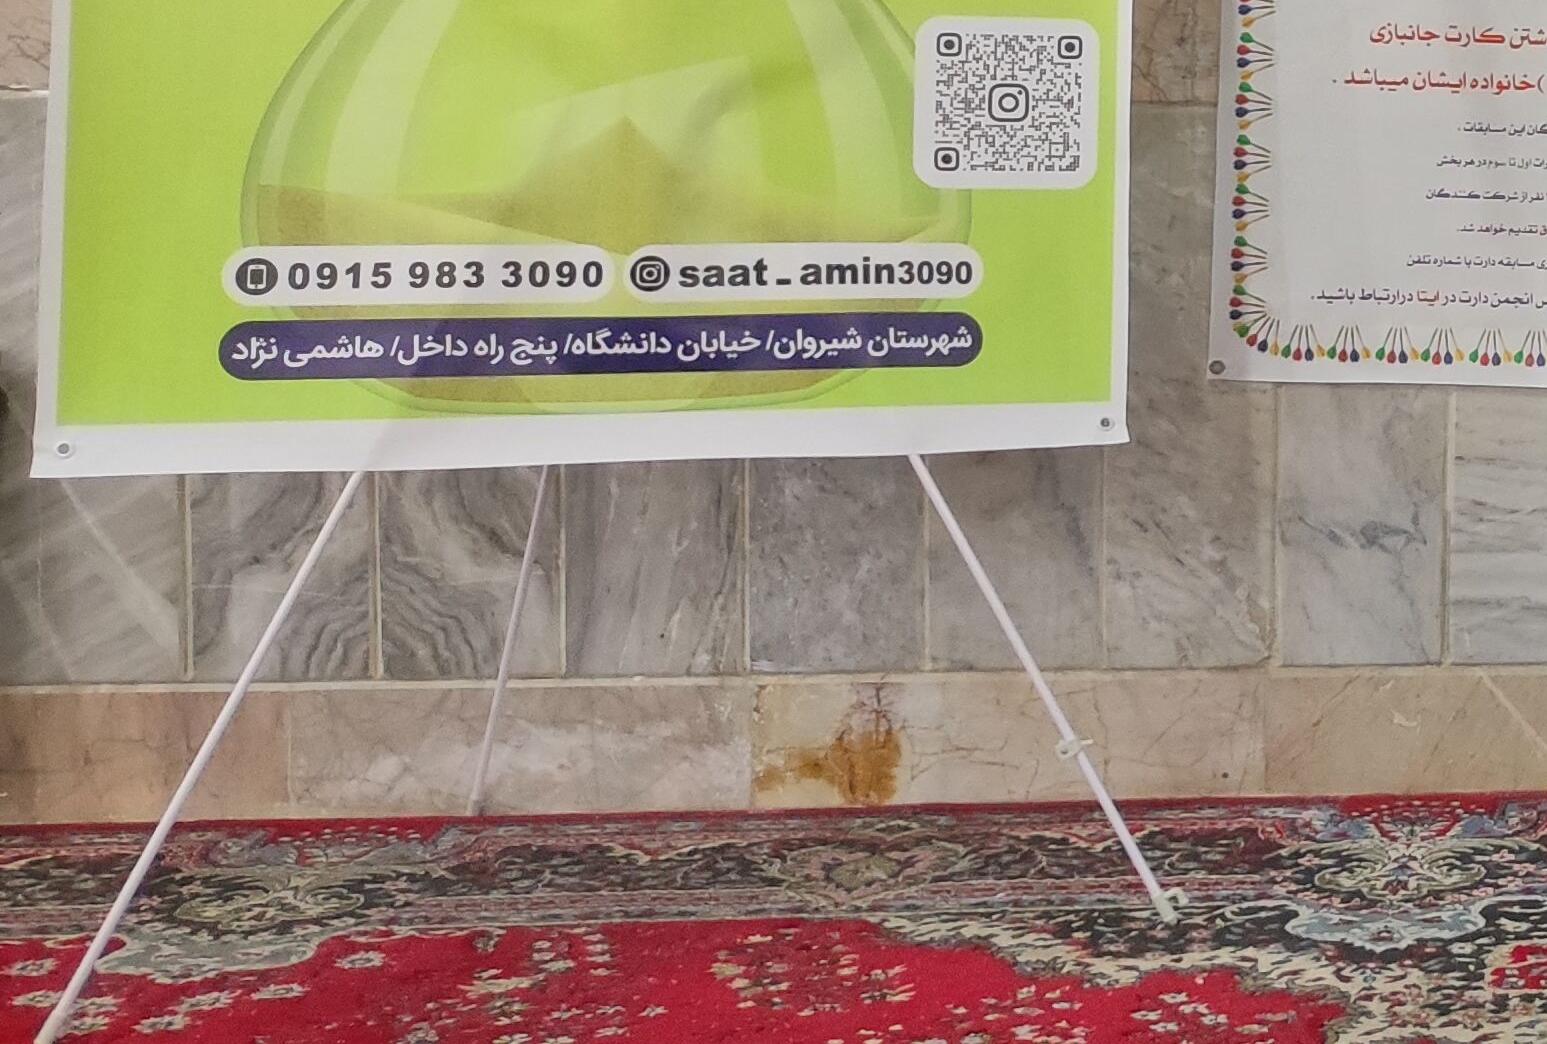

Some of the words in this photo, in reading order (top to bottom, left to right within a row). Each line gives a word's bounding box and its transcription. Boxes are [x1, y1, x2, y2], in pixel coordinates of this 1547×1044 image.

[1369, 22, 1441, 47] جانبازی
[1444, 24, 1506, 48] کارت
[1343, 68, 1409, 92] میباشد
[1412, 71, 1467, 93] ایشان
[287, 261, 392, 290] 0915
[408, 261, 485, 289] 983
[501, 260, 603, 288] 3090
[1459, 291, 1488, 307] دارت
[1490, 292, 1533, 308] انجمن
[231, 336, 278, 369] نژاد
[284, 335, 384, 368] هاشمی
[473, 334, 504, 364] راه
[510, 335, 558, 365] پنج
[676, 330, 762, 362] خیابان
[868, 326, 973, 357] شهرستان
